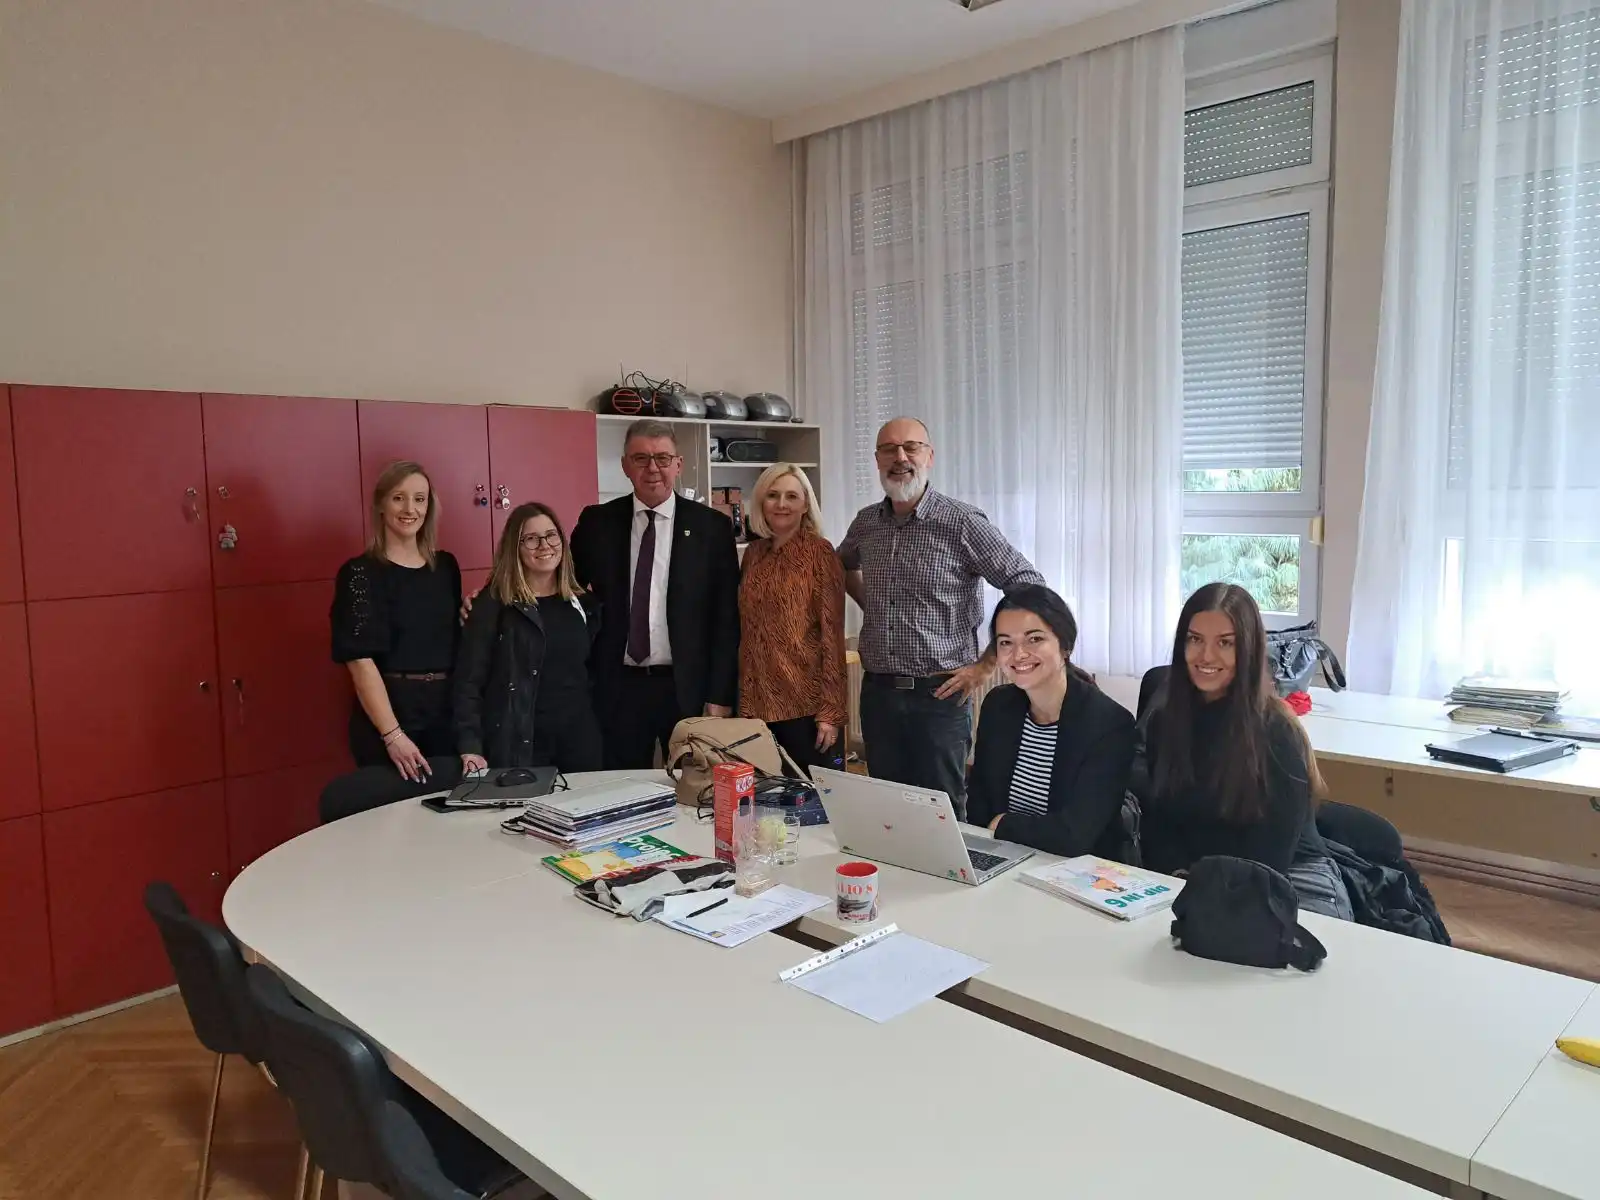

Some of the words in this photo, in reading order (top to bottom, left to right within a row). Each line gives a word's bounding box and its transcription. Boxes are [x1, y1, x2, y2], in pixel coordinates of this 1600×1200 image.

[1144, 885, 1171, 896] DIP
[1103, 898, 1128, 908] 6
[1120, 893, 1145, 903] IN
